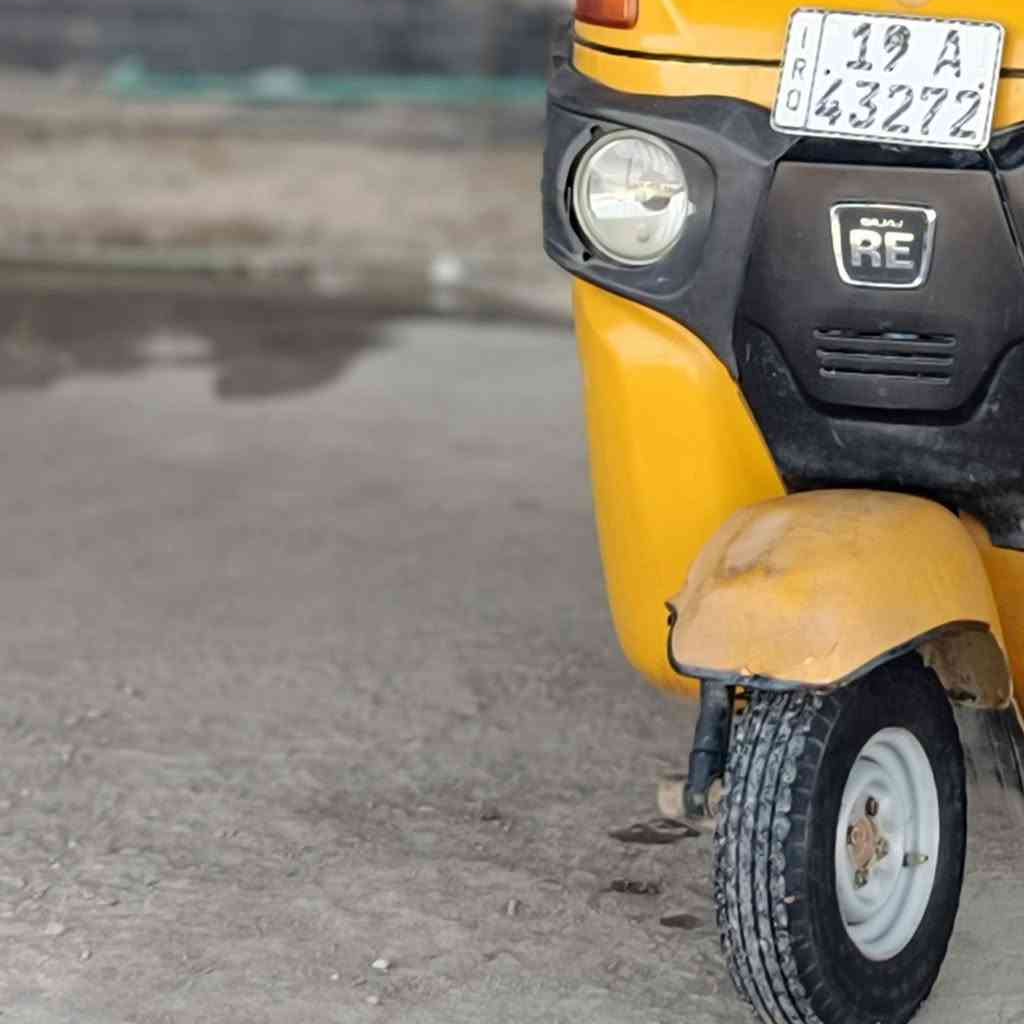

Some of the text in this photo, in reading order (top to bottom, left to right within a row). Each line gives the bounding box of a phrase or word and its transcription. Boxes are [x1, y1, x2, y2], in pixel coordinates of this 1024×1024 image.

[933, 30, 962, 78] A
[814, 78, 982, 139] 43272
[849, 228, 915, 270] RE
